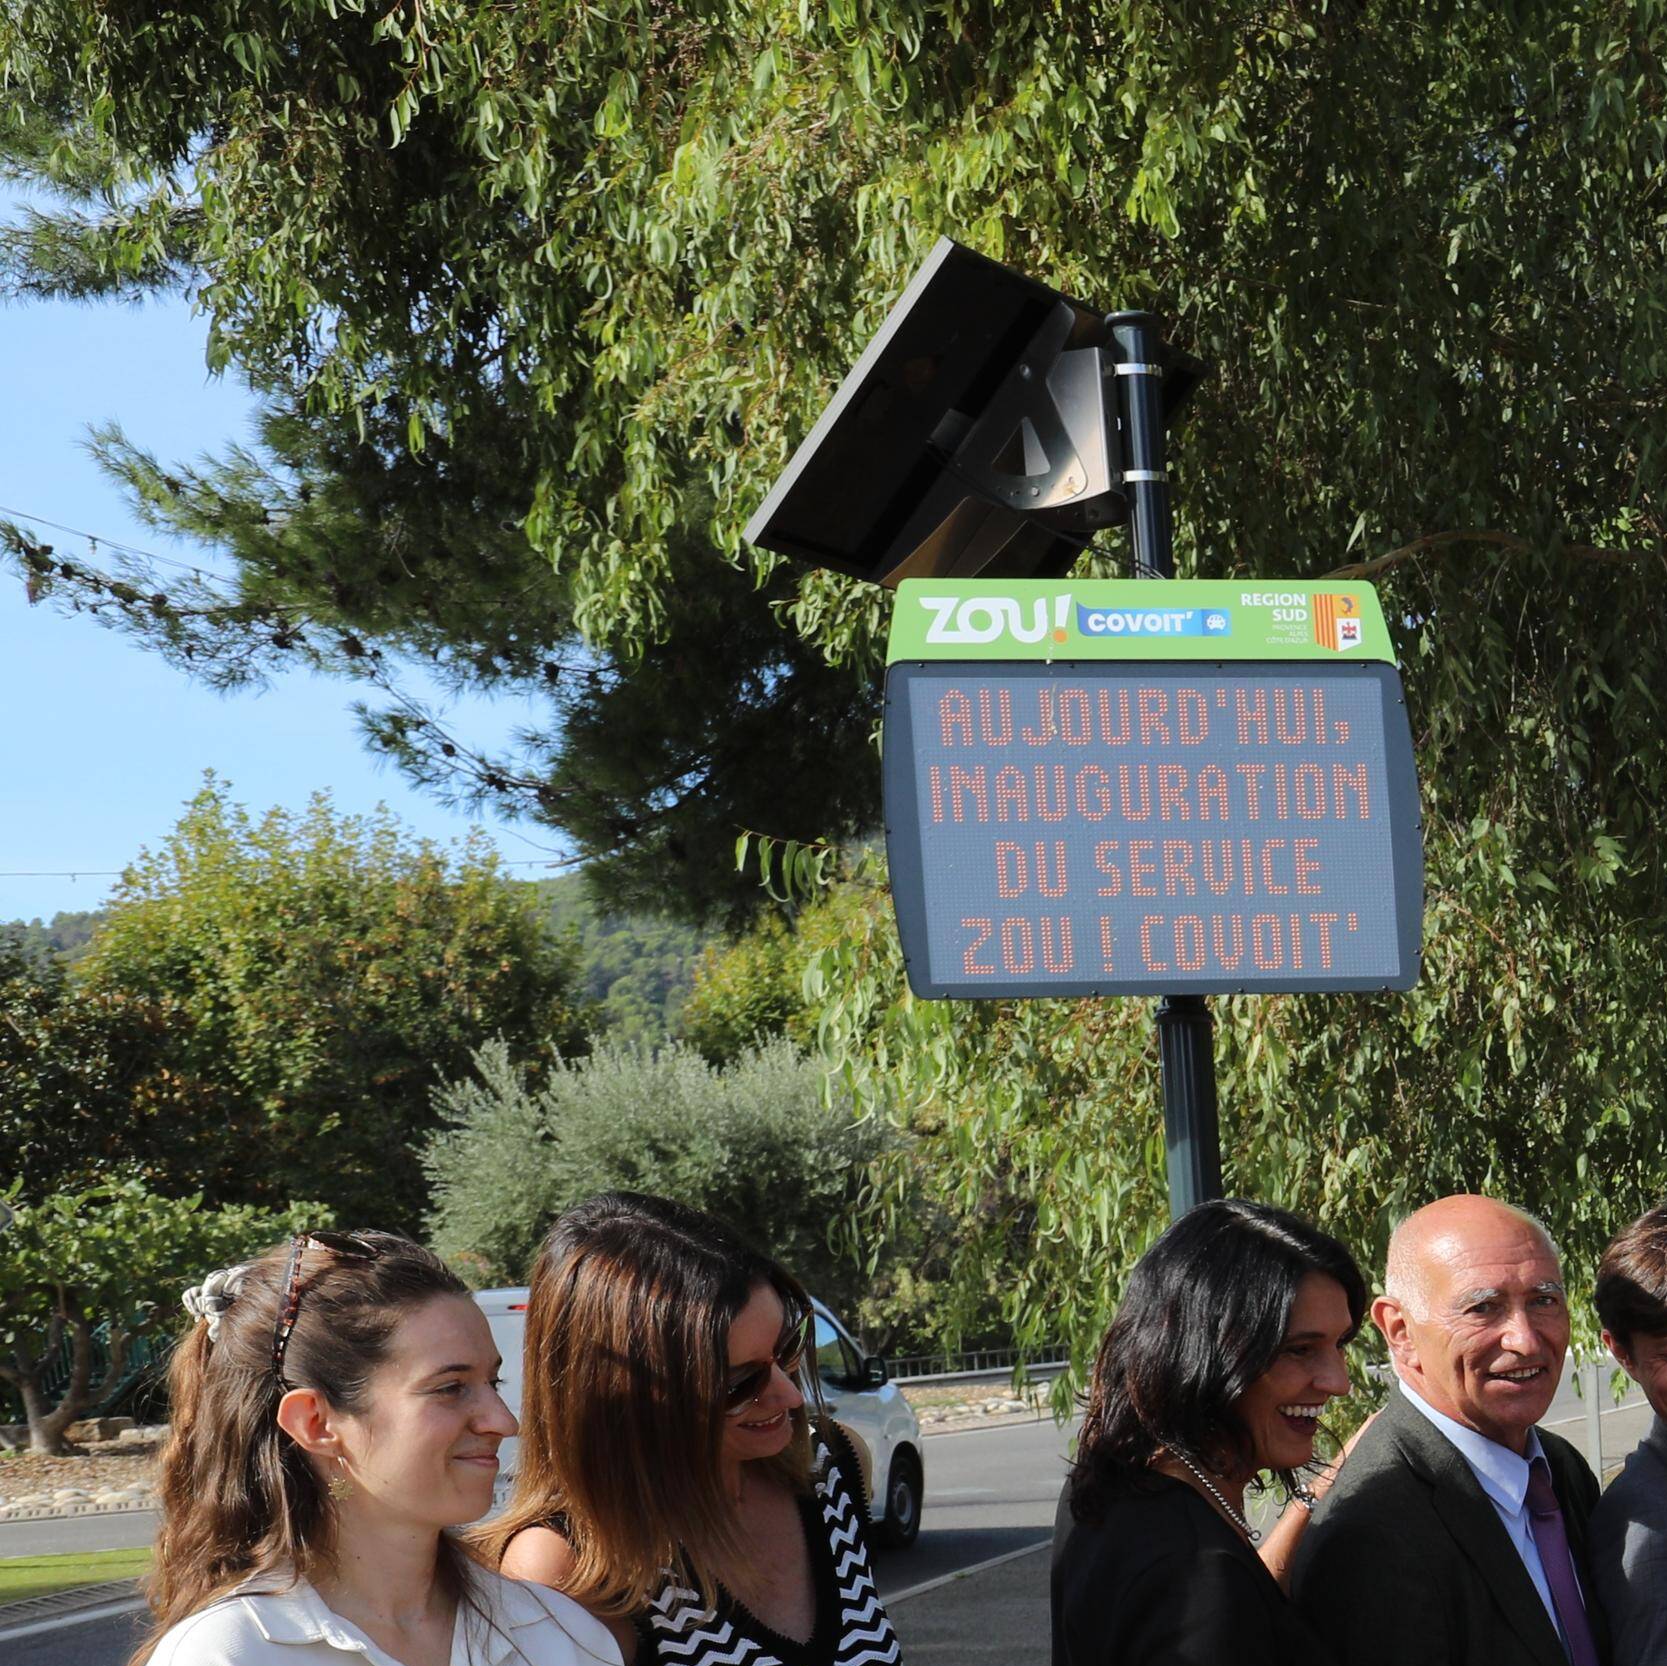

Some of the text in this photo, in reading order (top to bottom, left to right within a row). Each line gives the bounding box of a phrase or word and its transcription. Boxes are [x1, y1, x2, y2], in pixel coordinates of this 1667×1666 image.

[918, 593, 1072, 644] ZOU!
[1272, 608, 1308, 621] SUD
[937, 687, 1352, 747] AUJOURD'HUI,
[929, 763, 1371, 823] INAUGURATION
[995, 837, 1323, 899] DU SERVICE
[961, 912, 1360, 975] ZOU ! COVOIT'
